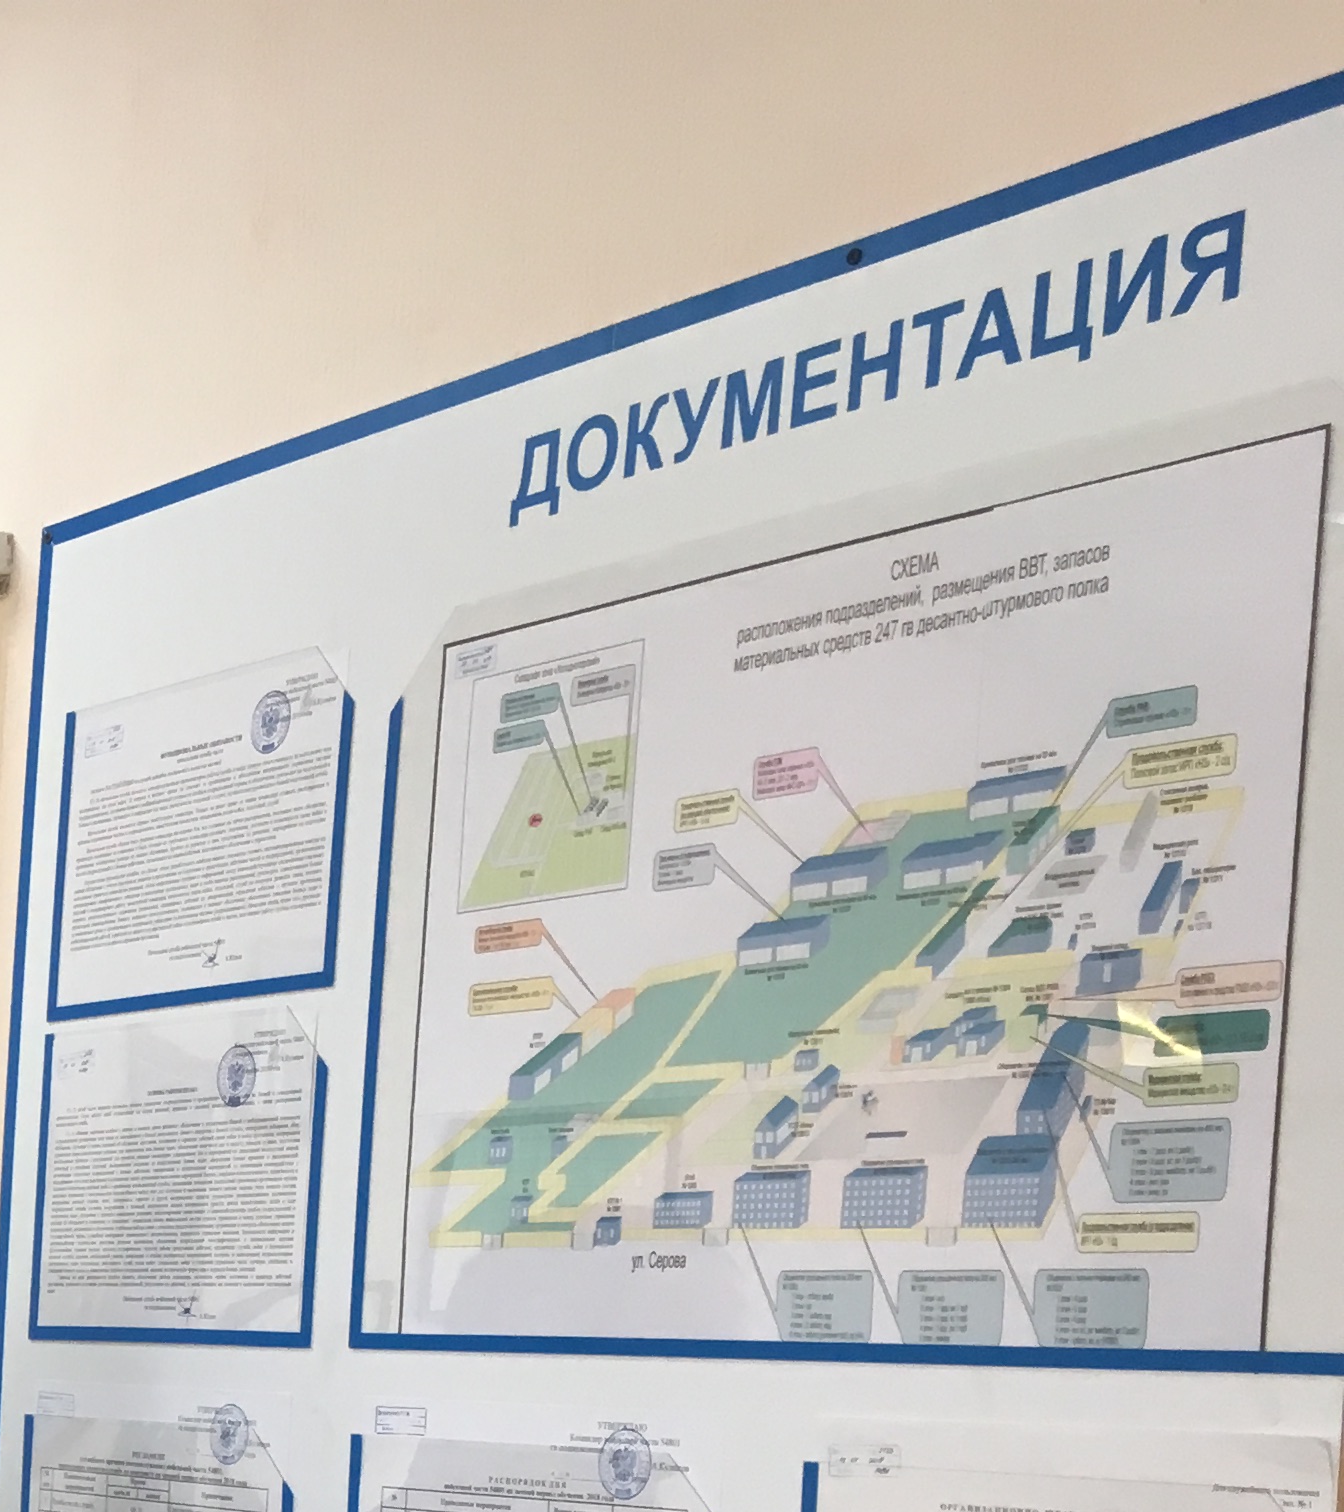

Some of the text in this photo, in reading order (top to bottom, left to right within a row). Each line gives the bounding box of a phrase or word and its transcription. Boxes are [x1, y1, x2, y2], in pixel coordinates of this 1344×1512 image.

[509, 209, 1247, 528] ДОКУМЕНТАЦИЯ
[736, 543, 1111, 649] расположения подразделений, размещения ВВТ, запасов
[890, 551, 940, 582] СХЕМА
[733, 574, 1110, 673] материальных средств 247 гв десантно-штурмового полка
[649, 1251, 687, 1272] Серова
